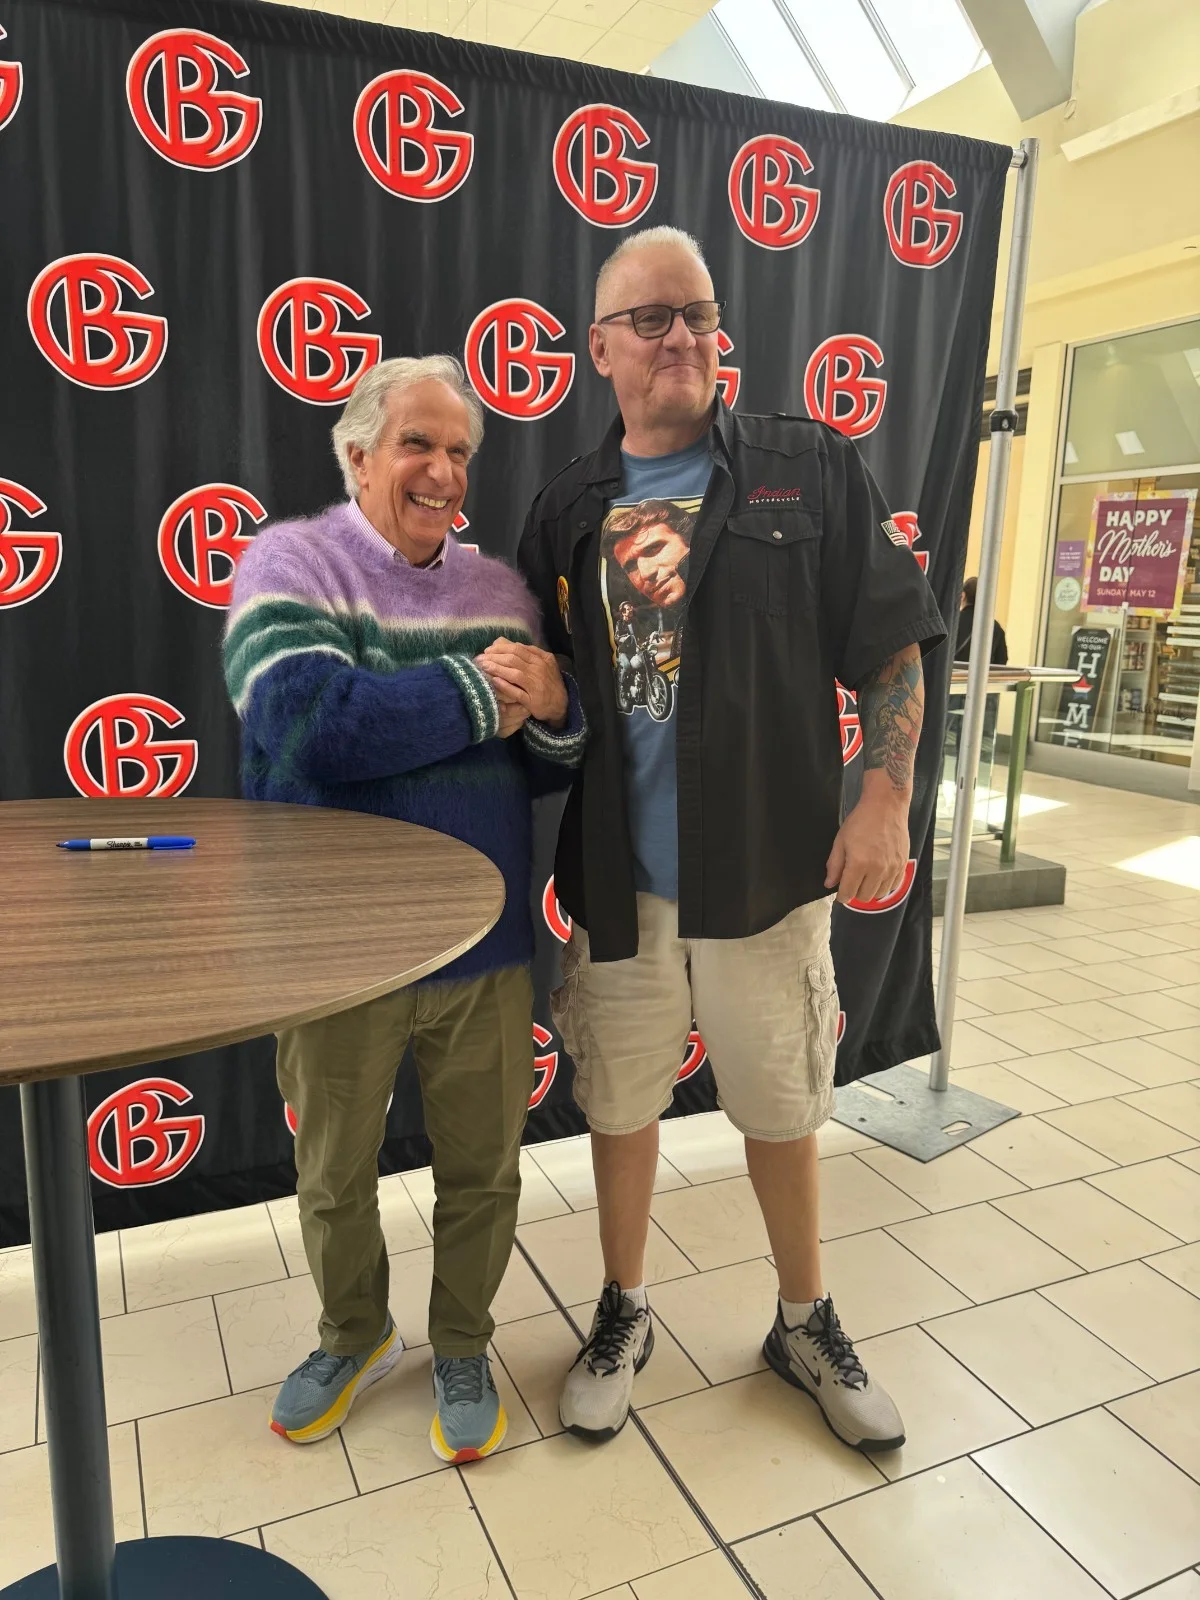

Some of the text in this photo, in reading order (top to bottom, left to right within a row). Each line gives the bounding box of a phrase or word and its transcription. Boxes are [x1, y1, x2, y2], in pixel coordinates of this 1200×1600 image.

[747, 485, 801, 499] Indian
[1106, 509, 1173, 531] HAPPY
[1097, 530, 1177, 564] Mother's
[1099, 566, 1135, 583] DAY
[1096, 587, 1157, 598] SUNDAY MAY 12
[1076, 635, 1109, 645] WELCOME
